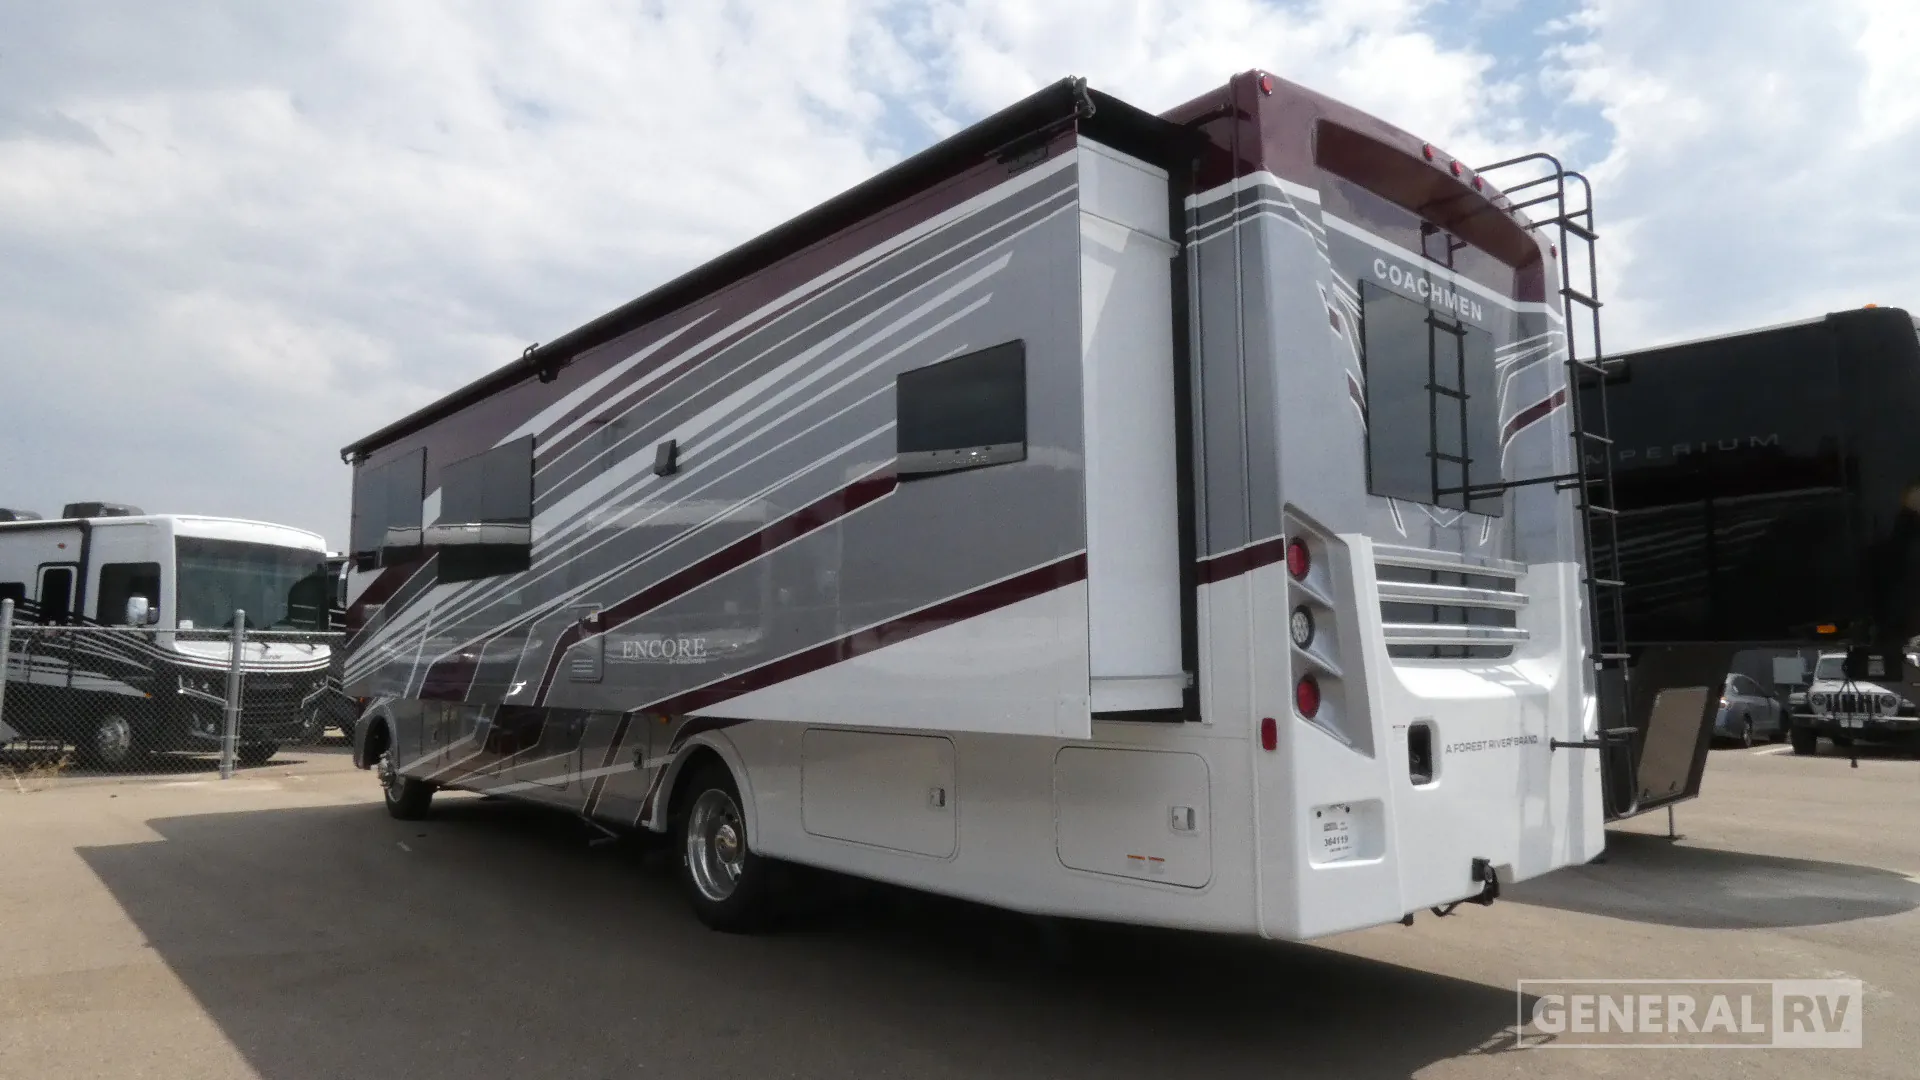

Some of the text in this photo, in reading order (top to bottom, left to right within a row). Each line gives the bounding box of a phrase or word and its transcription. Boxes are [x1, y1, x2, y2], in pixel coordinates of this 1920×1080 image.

[1373, 258, 1482, 321] COACHMEN
[620, 638, 707, 659] ENCORE
[1445, 743, 1453, 754] A
[1453, 740, 1488, 753] FOREST
[1514, 734, 1539, 746] BRAND
